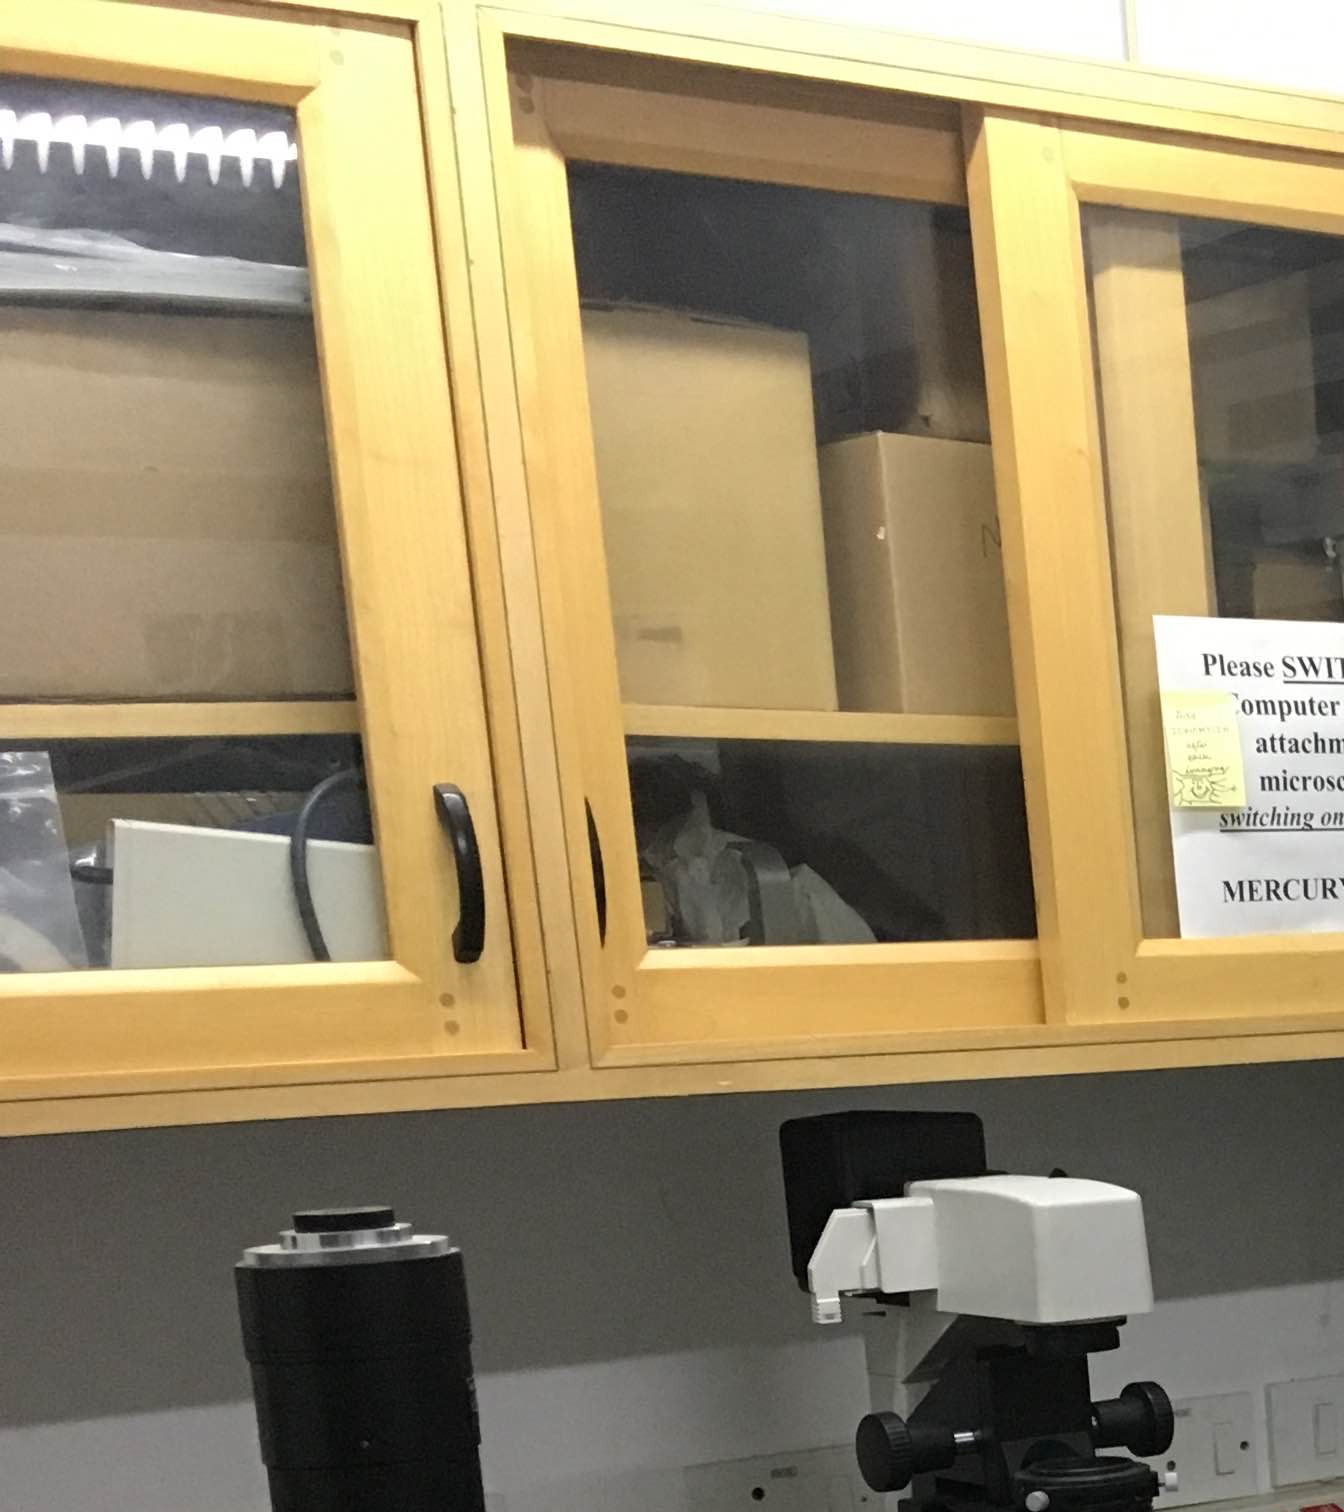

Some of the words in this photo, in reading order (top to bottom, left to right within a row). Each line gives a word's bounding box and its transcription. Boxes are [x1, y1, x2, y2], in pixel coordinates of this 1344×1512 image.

[1202, 653, 1275, 679] Please
[1229, 693, 1340, 722] omputer
[1219, 805, 1315, 831] switching
